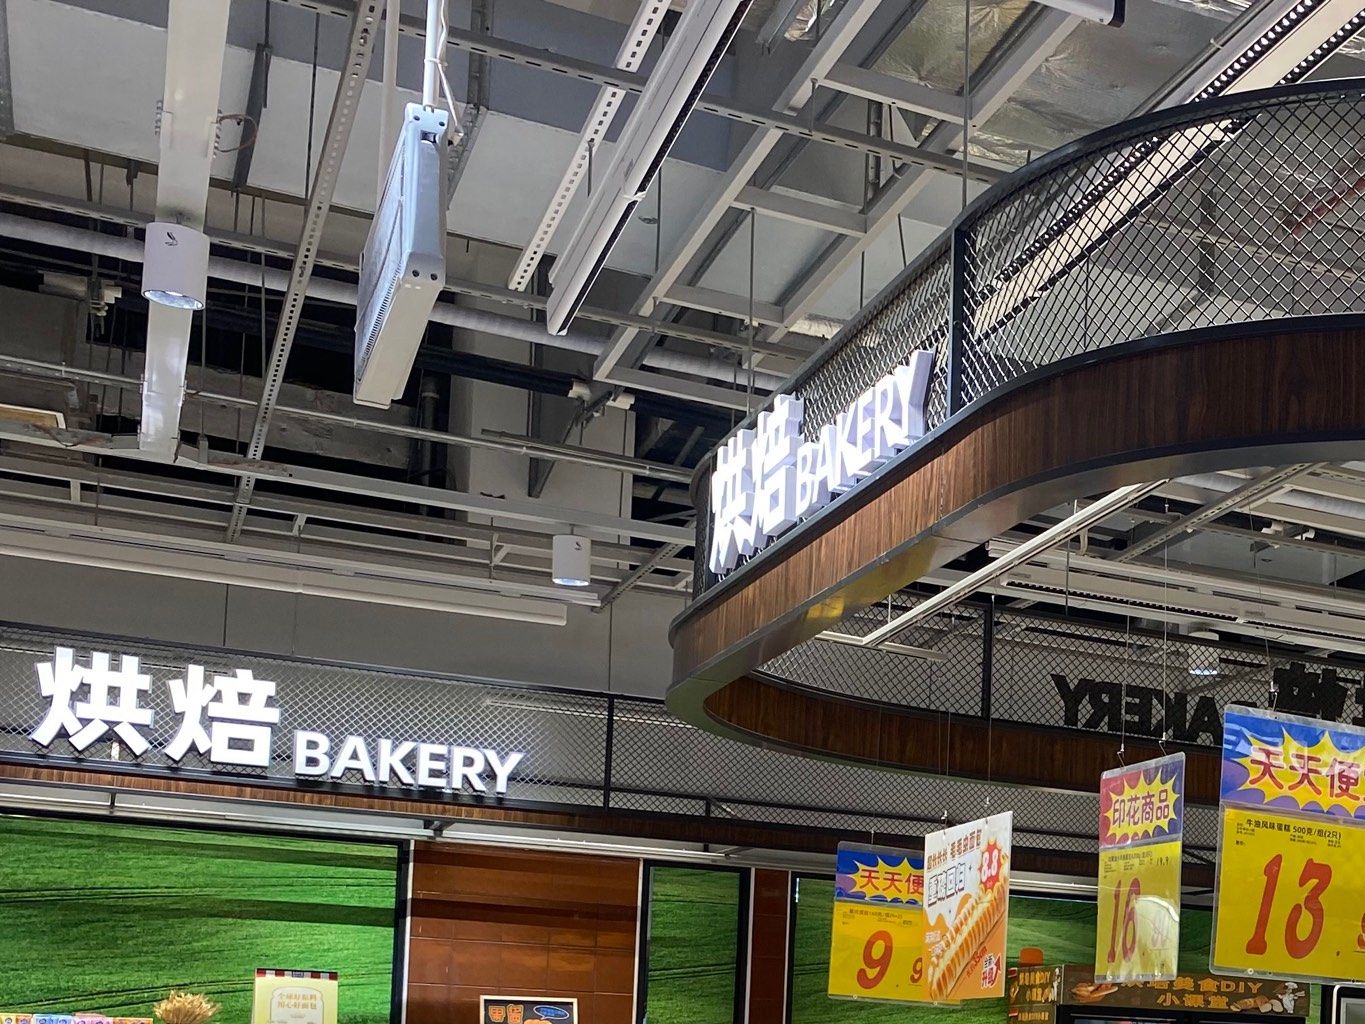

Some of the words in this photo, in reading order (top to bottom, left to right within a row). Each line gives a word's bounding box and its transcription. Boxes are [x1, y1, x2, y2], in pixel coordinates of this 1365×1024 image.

[708, 394, 804, 574] 烘焙
[796, 349, 937, 517] BAKERY
[28, 646, 281, 768] 烘焙
[294, 729, 526, 794] BAKERY
[1112, 788, 1169, 829] 印花商品
[1246, 819, 1291, 833] 牛油风味蛋糕
[981, 847, 999, 883] 8.8
